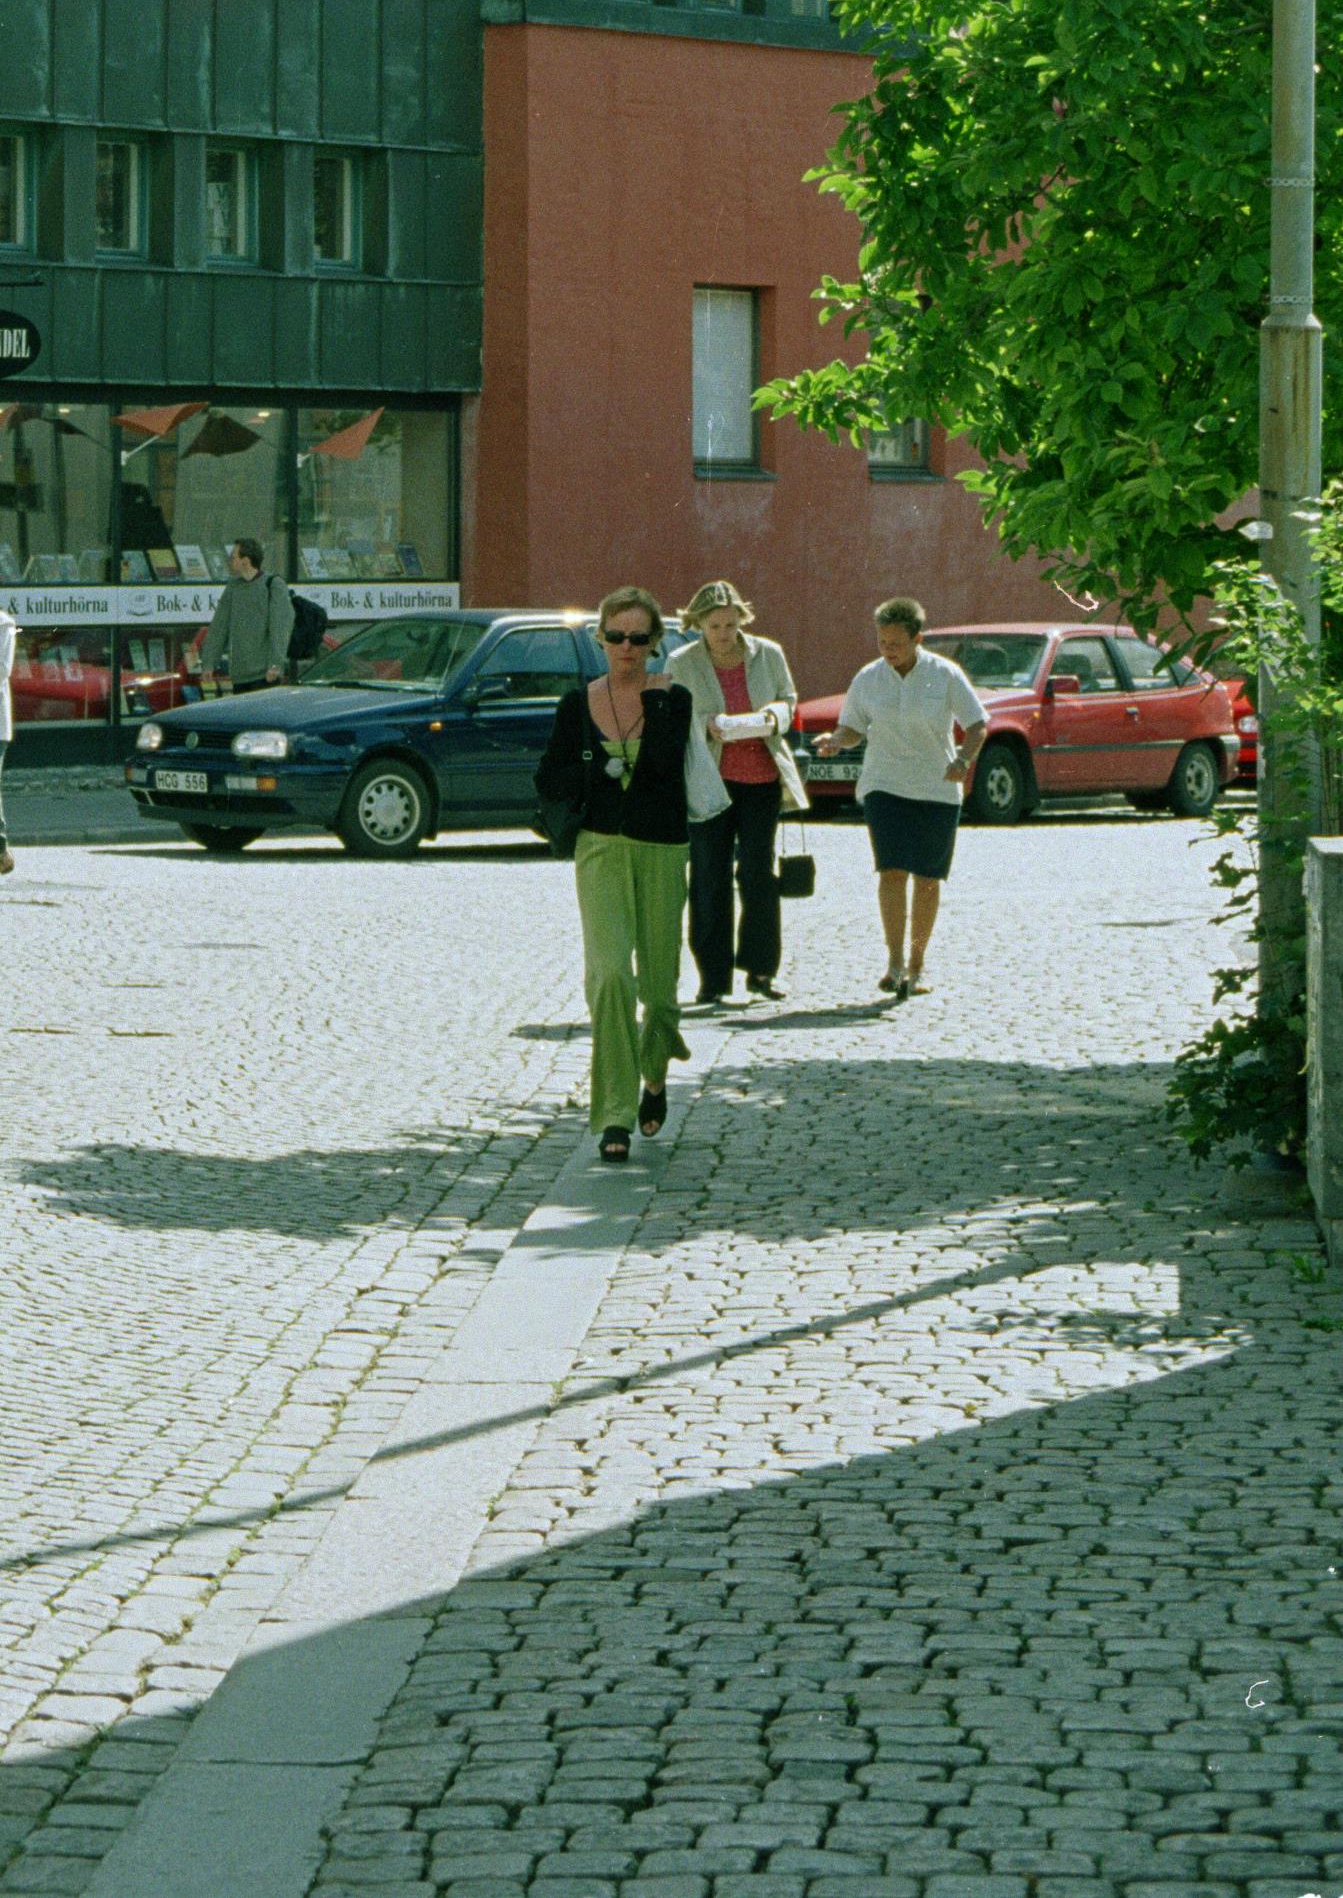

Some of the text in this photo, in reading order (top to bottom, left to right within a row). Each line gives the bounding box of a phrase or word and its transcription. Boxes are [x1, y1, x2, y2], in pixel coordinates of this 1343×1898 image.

[7, 597, 19, 615] &
[26, 594, 108, 615] kulturhörna
[157, 594, 188, 613] Bok-
[191, 594, 202, 613] &
[331, 588, 452, 610] Bok- & kulturhörna
